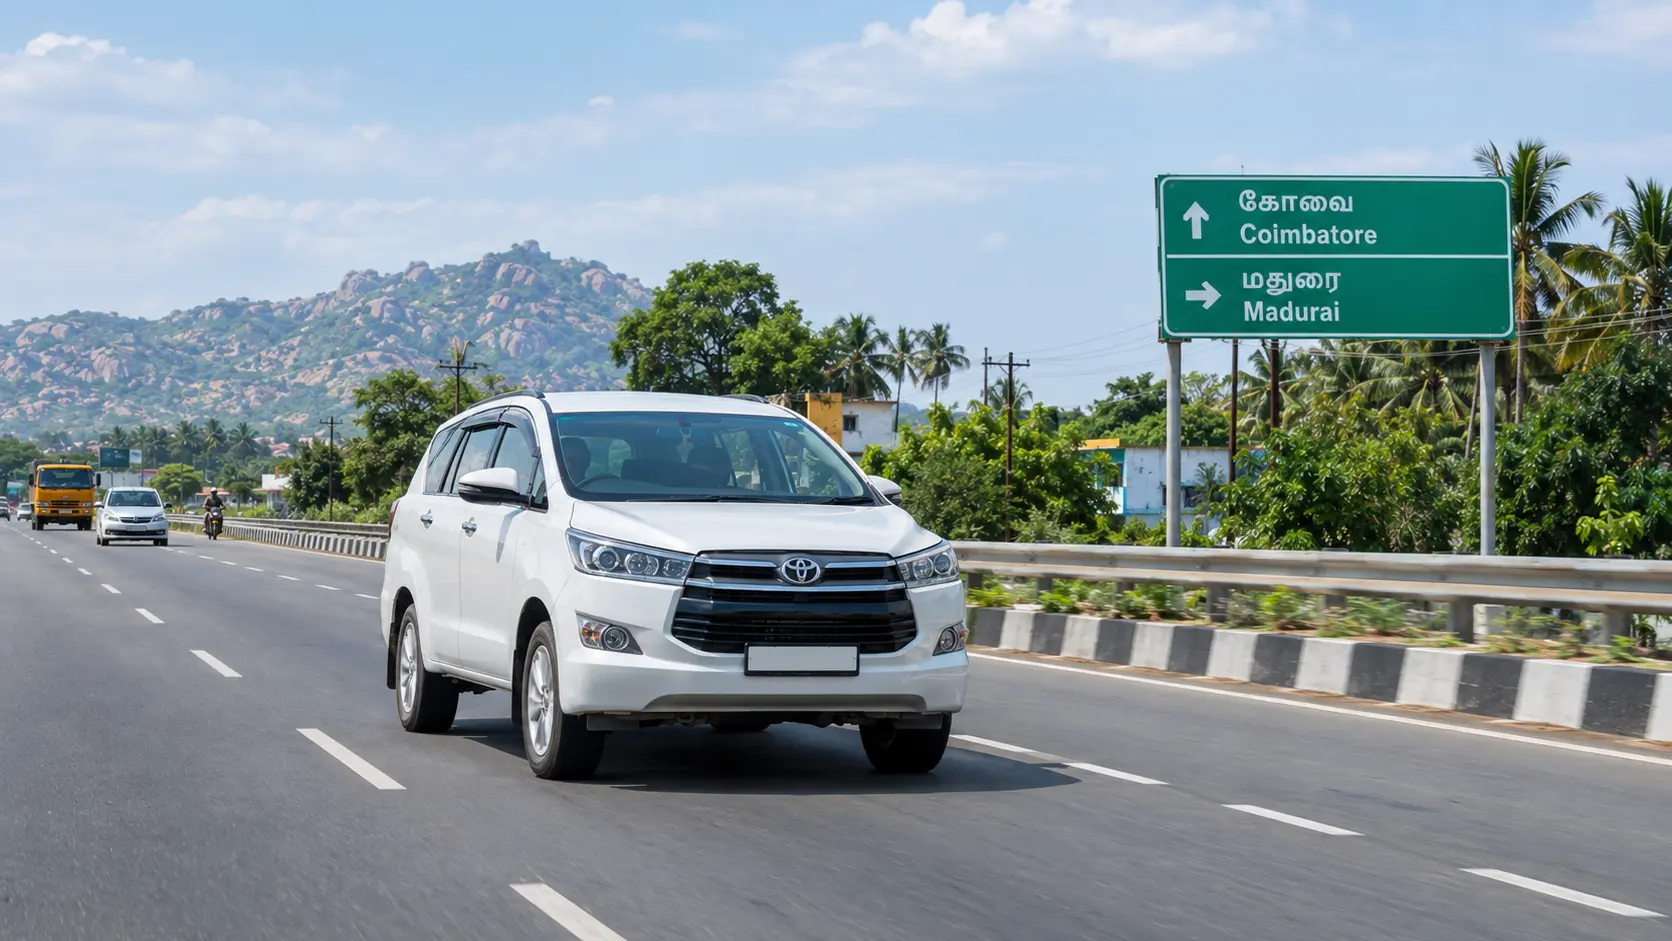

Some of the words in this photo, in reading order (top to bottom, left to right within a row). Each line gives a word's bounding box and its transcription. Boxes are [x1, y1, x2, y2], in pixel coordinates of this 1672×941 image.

[1239, 189, 1353, 212] கோவை
[1240, 223, 1377, 244] Coimbatore
[1242, 272, 1341, 296] மதுரை
[1244, 301, 1339, 322] Madurai
